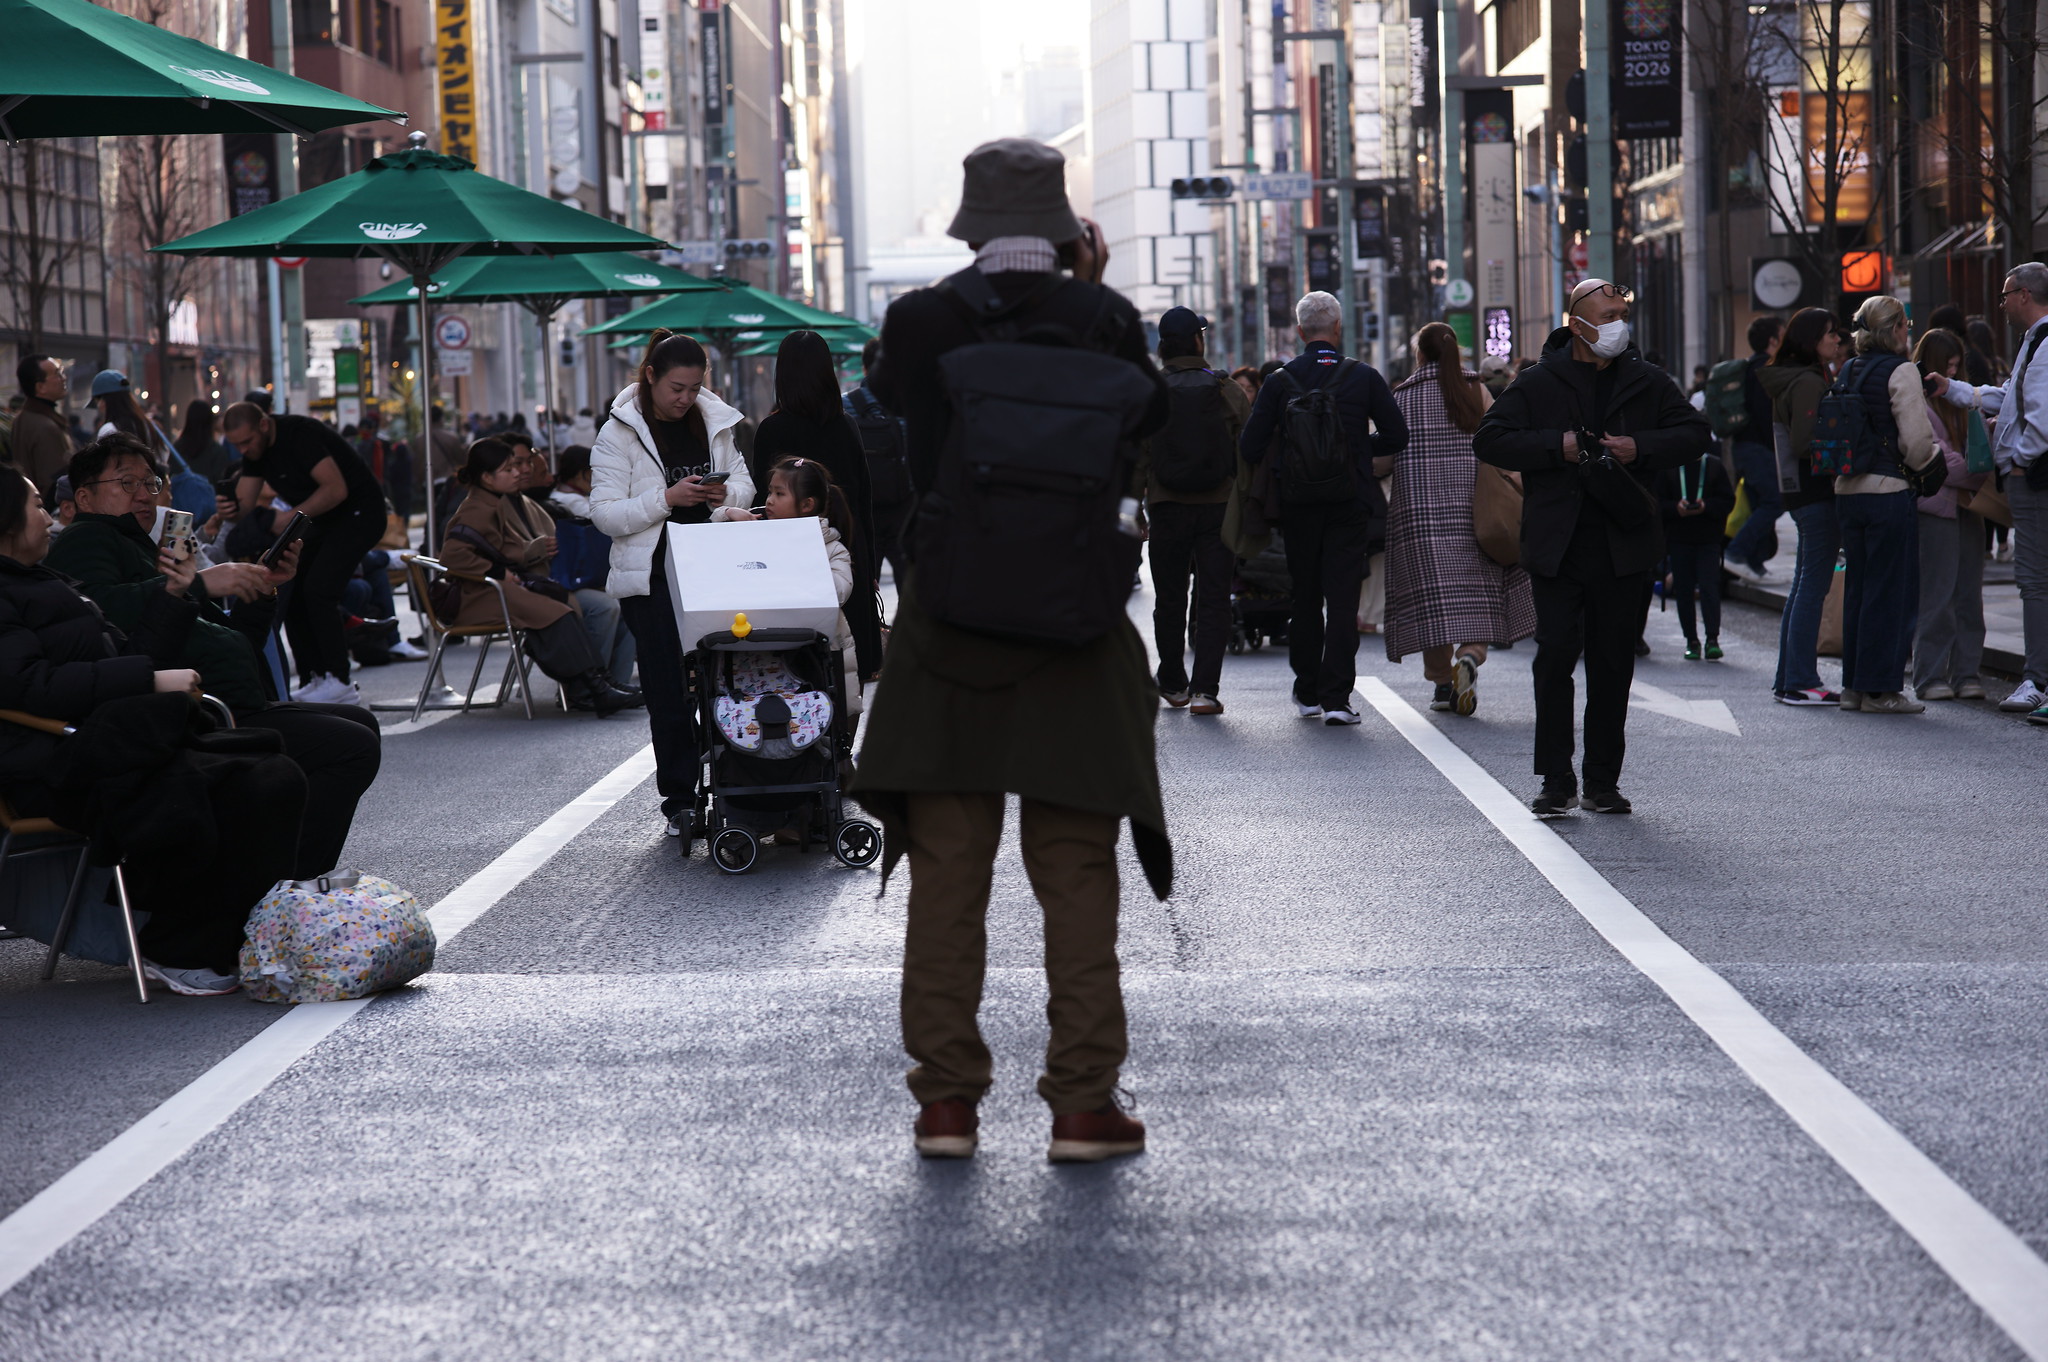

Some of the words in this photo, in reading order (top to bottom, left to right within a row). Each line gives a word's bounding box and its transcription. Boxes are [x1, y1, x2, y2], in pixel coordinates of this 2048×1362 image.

[1624, 40, 1671, 53] TOKYO
[1624, 61, 1671, 78] 2026
[358, 221, 428, 232] GINZA
